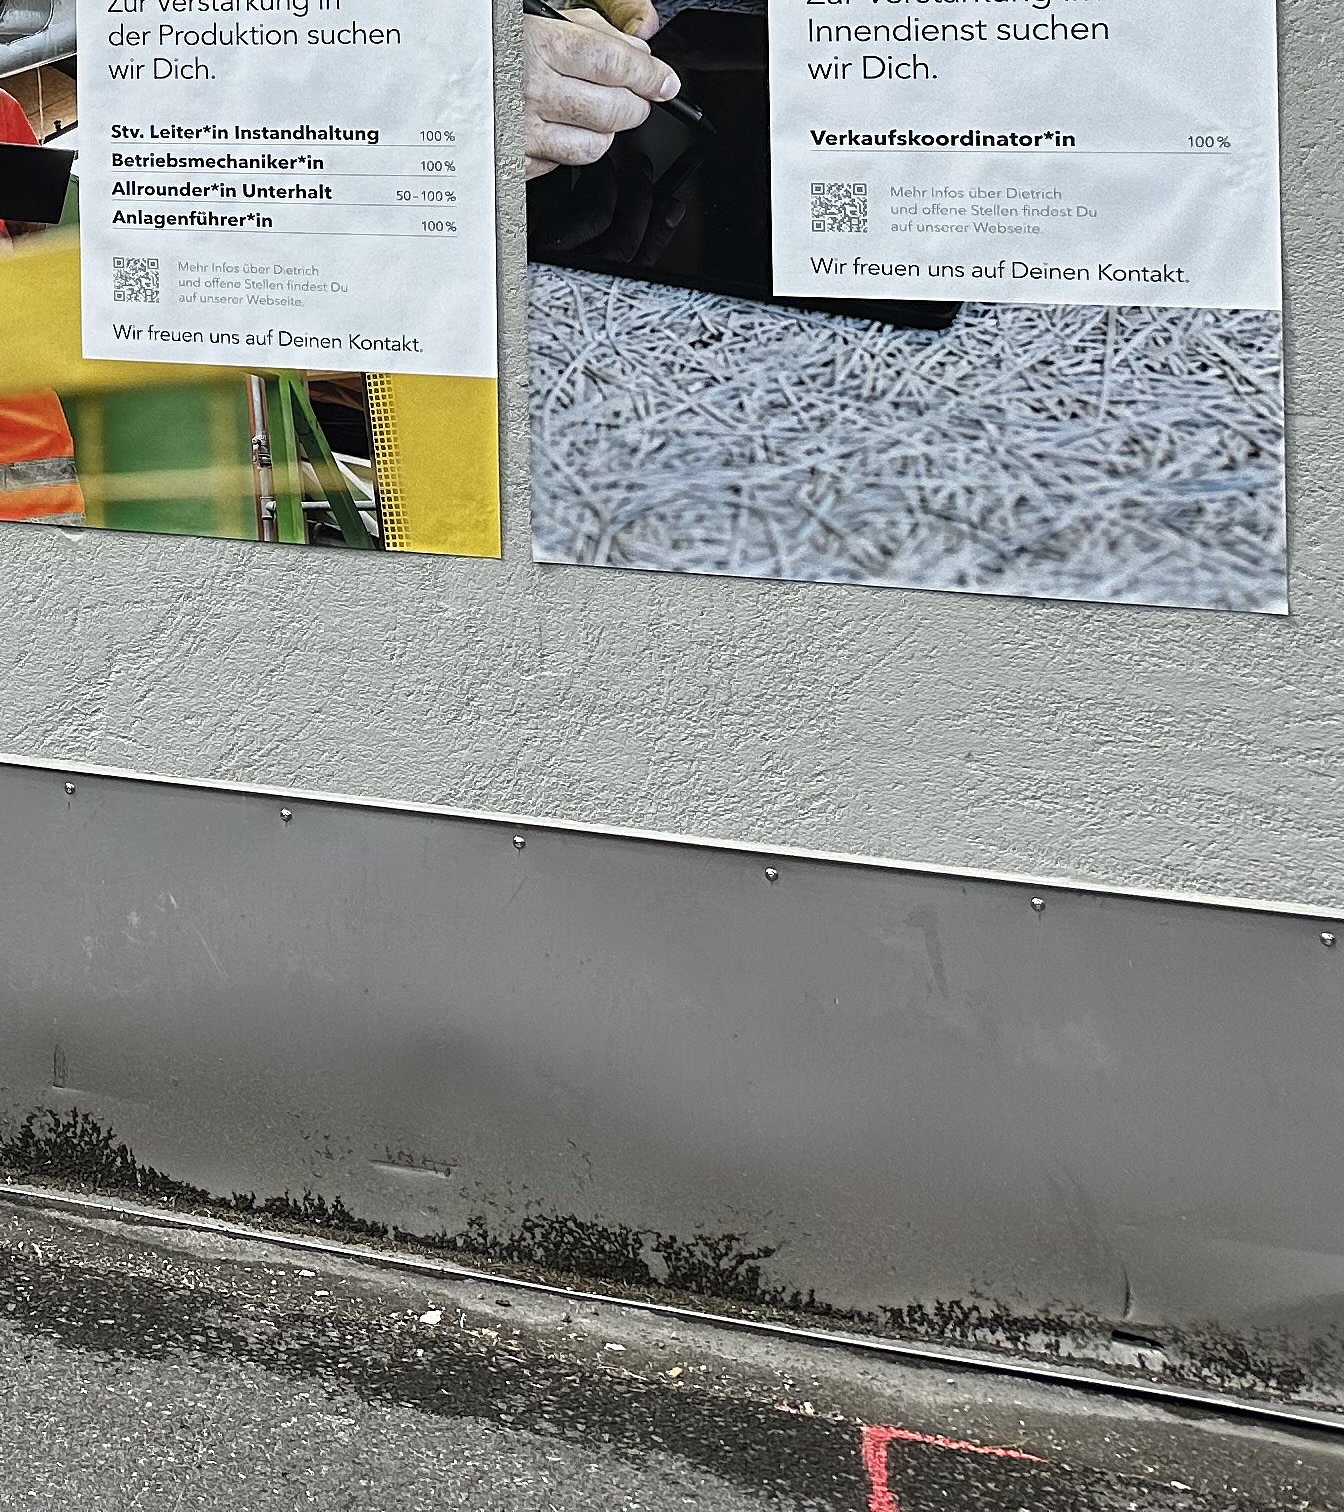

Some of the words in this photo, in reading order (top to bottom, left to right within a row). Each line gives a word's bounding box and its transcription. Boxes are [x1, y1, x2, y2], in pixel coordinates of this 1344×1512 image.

[108, 22, 152, 47] der
[159, 21, 298, 46] Produktion
[307, 20, 401, 45] suchen
[808, 15, 988, 43] Innendienst
[996, 13, 1109, 41] suchen
[108, 57, 146, 80] wir
[153, 56, 216, 80] Dich.
[807, 55, 853, 80] wir
[862, 53, 938, 80] Dich.
[111, 124, 144, 139] Stv.
[234, 124, 379, 146] Instandhaltung
[242, 183, 333, 200] Unterhalt
[890, 185, 928, 199] Mehr
[931, 185, 965, 199] Infos
[968, 186, 1003, 199] über
[1005, 187, 1063, 200] Dietrich
[890, 202, 918, 215] und
[921, 202, 967, 216] offene
[970, 203, 1019, 217] Stellen
[1021, 204, 1074, 218] findest
[1076, 205, 1098, 218] Du
[890, 219, 913, 232] auf
[916, 223, 971, 233] unserer
[177, 260, 209, 273] Mehr
[211, 261, 240, 274] Infos
[242, 262, 271, 275] über
[273, 264, 319, 277] Dietrich
[810, 256, 848, 275] Wir
[852, 256, 920, 277] freuen
[928, 265, 965, 278] uns
[971, 259, 1006, 279] auf
[1011, 261, 1090, 281] Deinen
[1098, 263, 1191, 284] Kontakt.
[178, 277, 201, 288] und
[204, 277, 242, 289] offene
[244, 278, 284, 291] Stellen
[286, 279, 328, 293] findest
[330, 281, 349, 293] Du
[178, 291, 197, 303] auf
[199, 295, 244, 305] unserer
[112, 323, 144, 341] Wir
[147, 324, 204, 343] freuen
[209, 332, 240, 345] uns
[245, 328, 274, 346] auf
[278, 330, 343, 349] Deinen
[348, 333, 424, 353] Kontakt.
